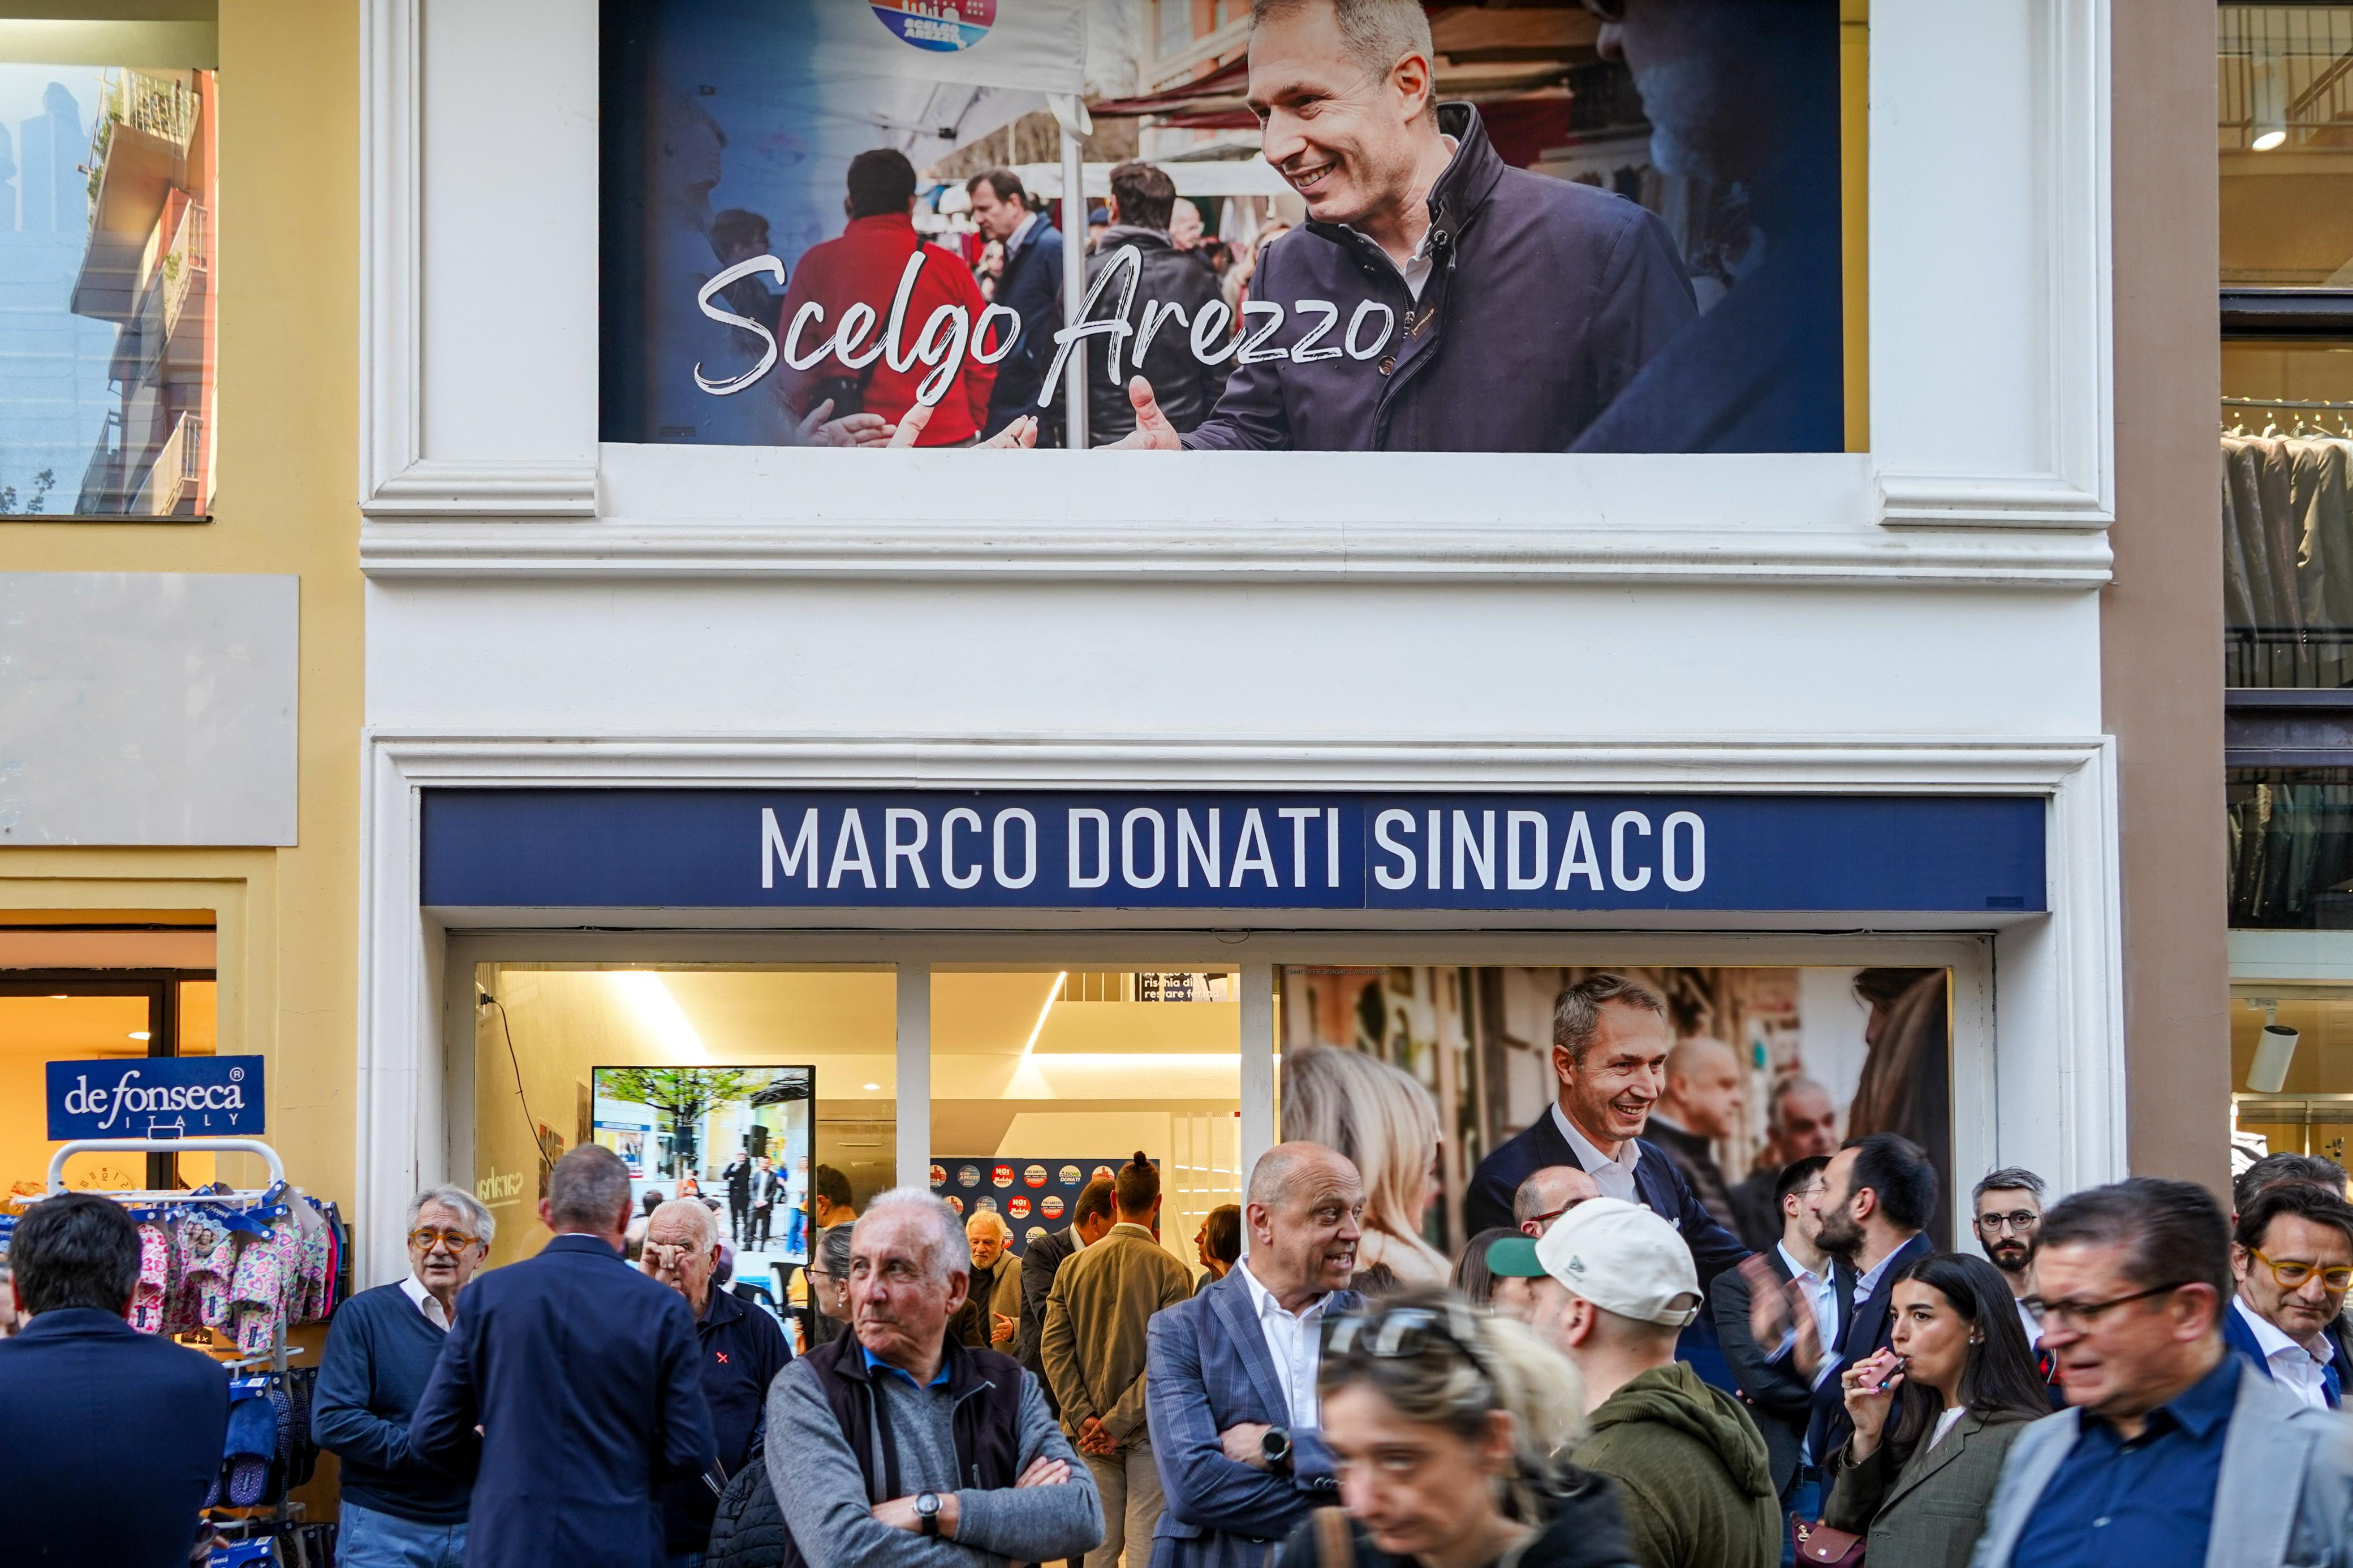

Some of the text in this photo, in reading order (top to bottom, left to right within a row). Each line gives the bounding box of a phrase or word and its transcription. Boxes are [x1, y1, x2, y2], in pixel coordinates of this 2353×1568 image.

[694, 244, 1394, 408] Scelgo Arezzo
[761, 807, 1705, 892] MARCO DONATI SINDACO
[1144, 978, 1193, 987] rishia di
